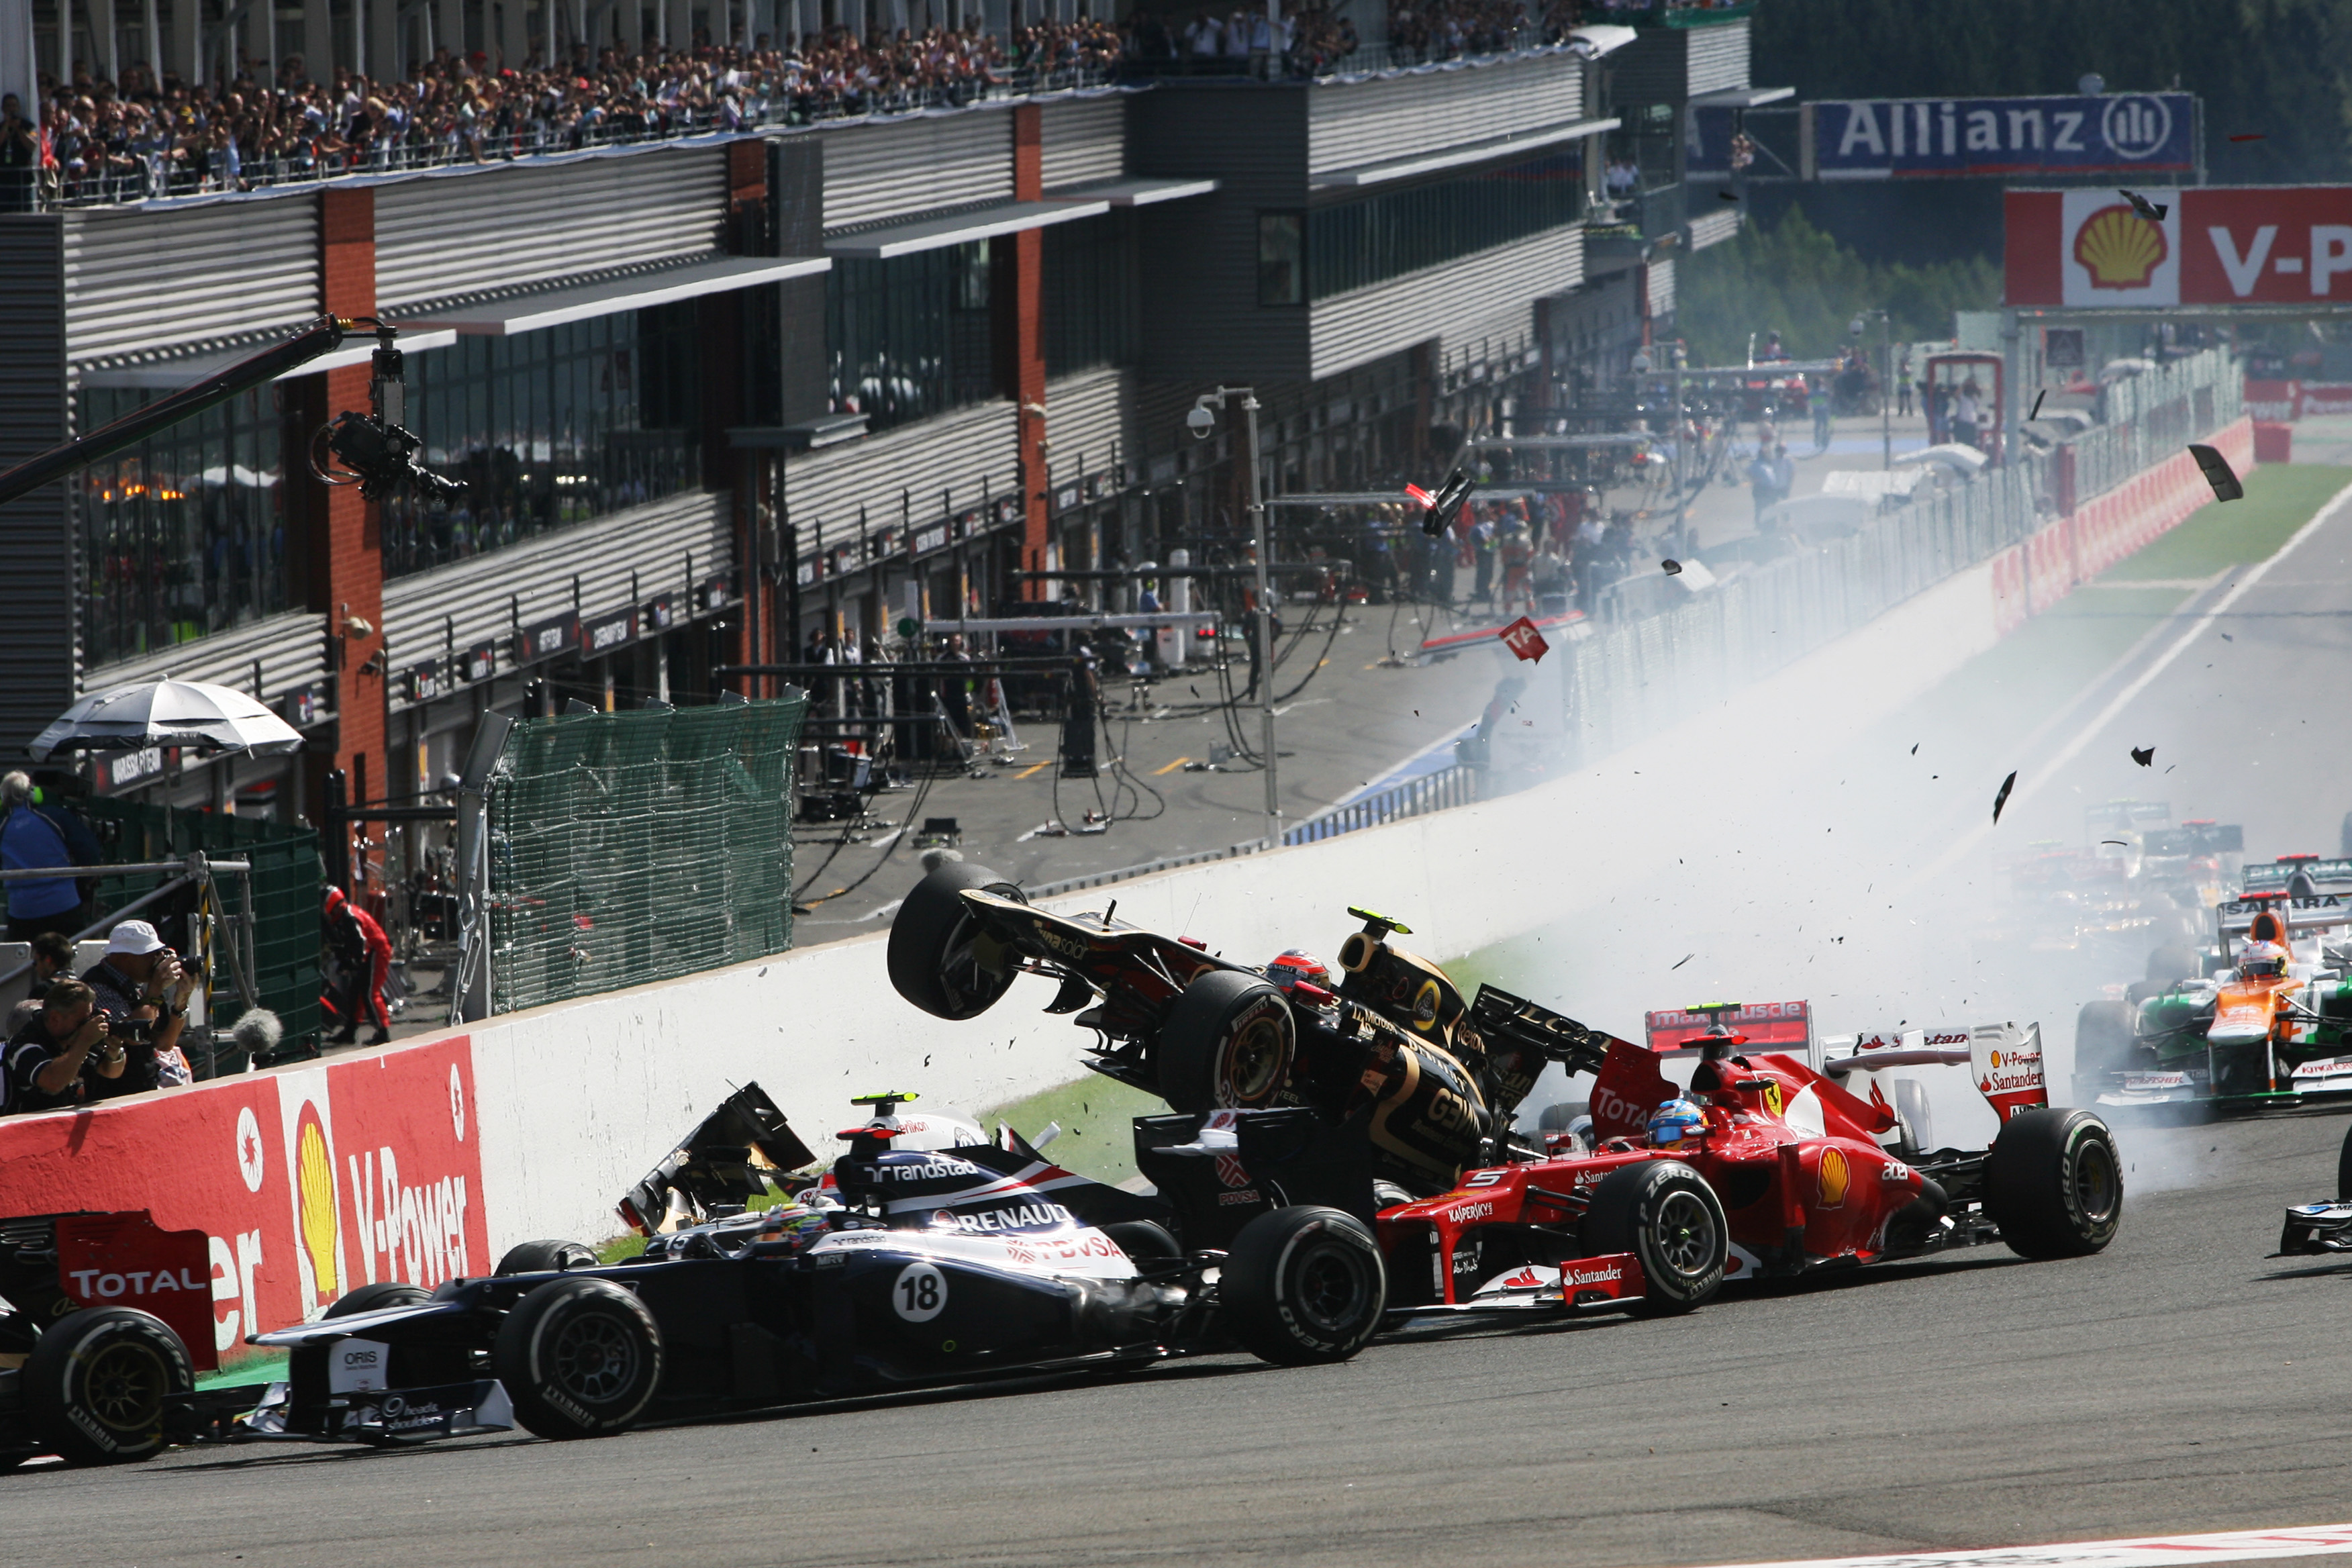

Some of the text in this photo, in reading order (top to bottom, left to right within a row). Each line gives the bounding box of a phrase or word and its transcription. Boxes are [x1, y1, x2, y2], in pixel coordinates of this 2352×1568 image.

[1839, 103, 2086, 156] Allianz
[1992, 1067, 2043, 1091] Santander
[1598, 1086, 1648, 1131] TOTA
[893, 1156, 979, 1182] randstad
[1465, 1171, 1509, 1187] 5
[1881, 1162, 1908, 1180] acer
[1646, 1168, 1694, 1199] ZERO
[2062, 1157, 2082, 1226] ZERO
[1219, 1190, 1261, 1206] PDVSA
[348, 1146, 469, 1287] V-Power
[957, 1204, 1075, 1233] RENAULT
[664, 1234, 690, 1251] 15
[69, 1268, 207, 1299] TOTAL
[1574, 1263, 1622, 1285] Santander
[900, 1274, 940, 1312] 18
[344, 1351, 377, 1365] ORIS
[388, 1414, 444, 1431] shoulders
